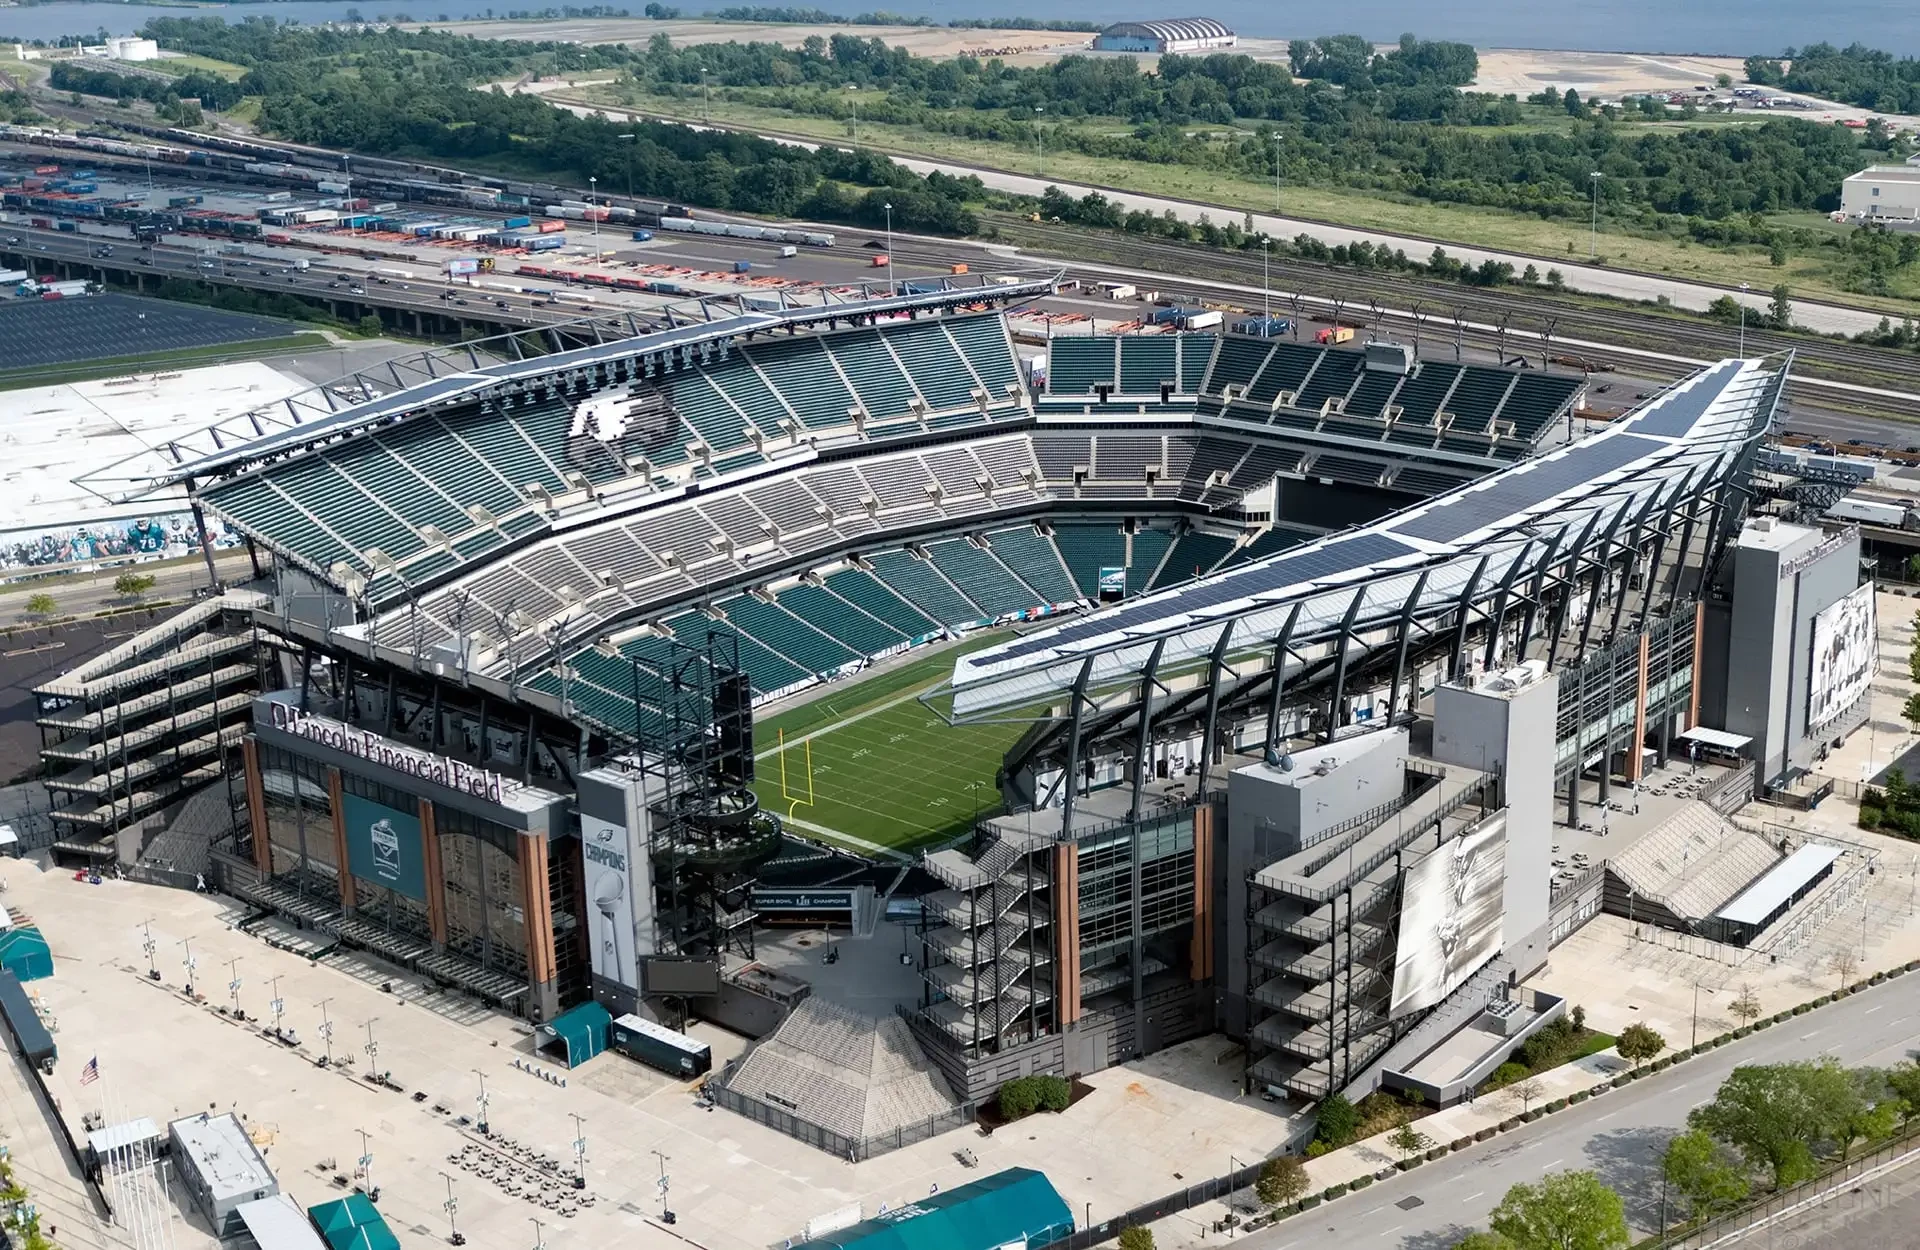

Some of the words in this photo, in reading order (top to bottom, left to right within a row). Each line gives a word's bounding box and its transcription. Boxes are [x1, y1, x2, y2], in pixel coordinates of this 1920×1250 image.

[291, 707, 361, 753] Lincoln
[363, 729, 450, 786] Financial
[451, 759, 502, 804] Field
[585, 842, 626, 872] CHAMPIONS
